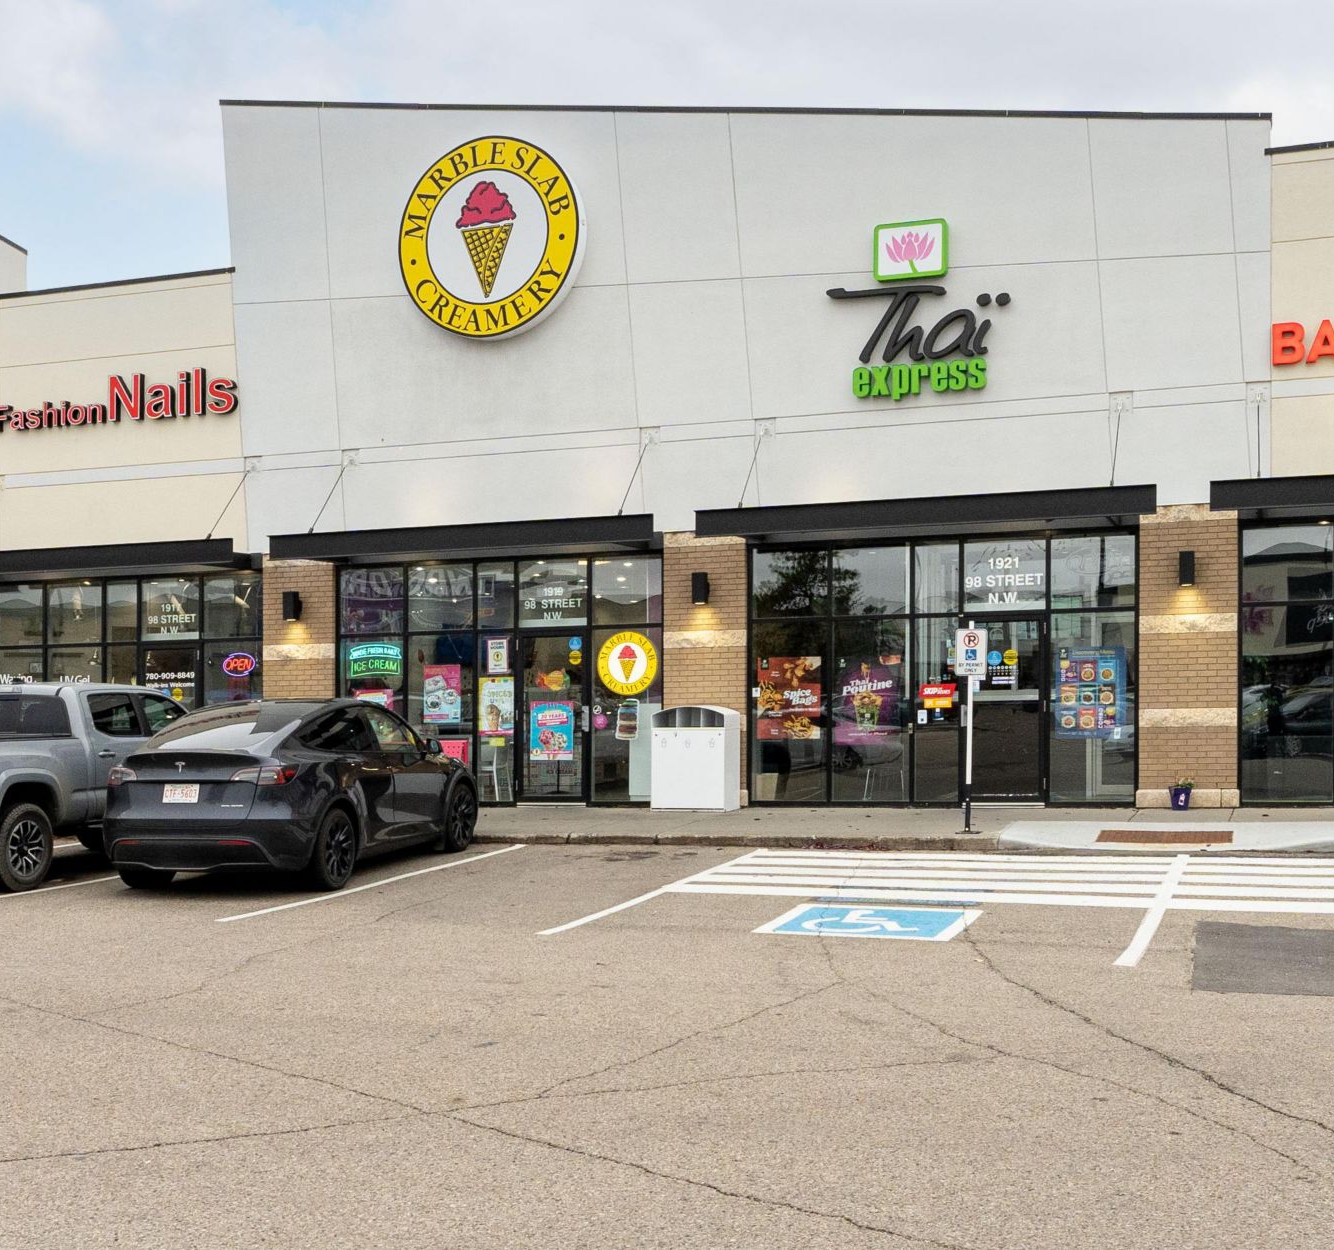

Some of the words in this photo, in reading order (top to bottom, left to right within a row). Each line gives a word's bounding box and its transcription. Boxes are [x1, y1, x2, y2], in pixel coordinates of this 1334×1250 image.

[404, 142, 506, 241] MARBLE
[511, 146, 570, 216] SLAB
[416, 257, 562, 332] CREAMERY
[826, 285, 1011, 363] Thaï
[852, 357, 987, 401] express
[108, 367, 237, 421] Nails
[988, 557, 1019, 570] 1921
[965, 576, 982, 588] 98
[986, 573, 1043, 586] STREET
[524, 600, 536, 609] 98
[541, 598, 582, 609] STREET
[988, 592, 1019, 604] N.W.
[147, 616, 158, 624] 98
[160, 614, 196, 623] STREET
[225, 659, 252, 671] OPEN
[354, 661, 367, 671] ICE
[368, 659, 397, 671] CREAM
[783, 688, 812, 700] Spice
[842, 679, 893, 696] Poutine
[791, 695, 818, 706] Bags
